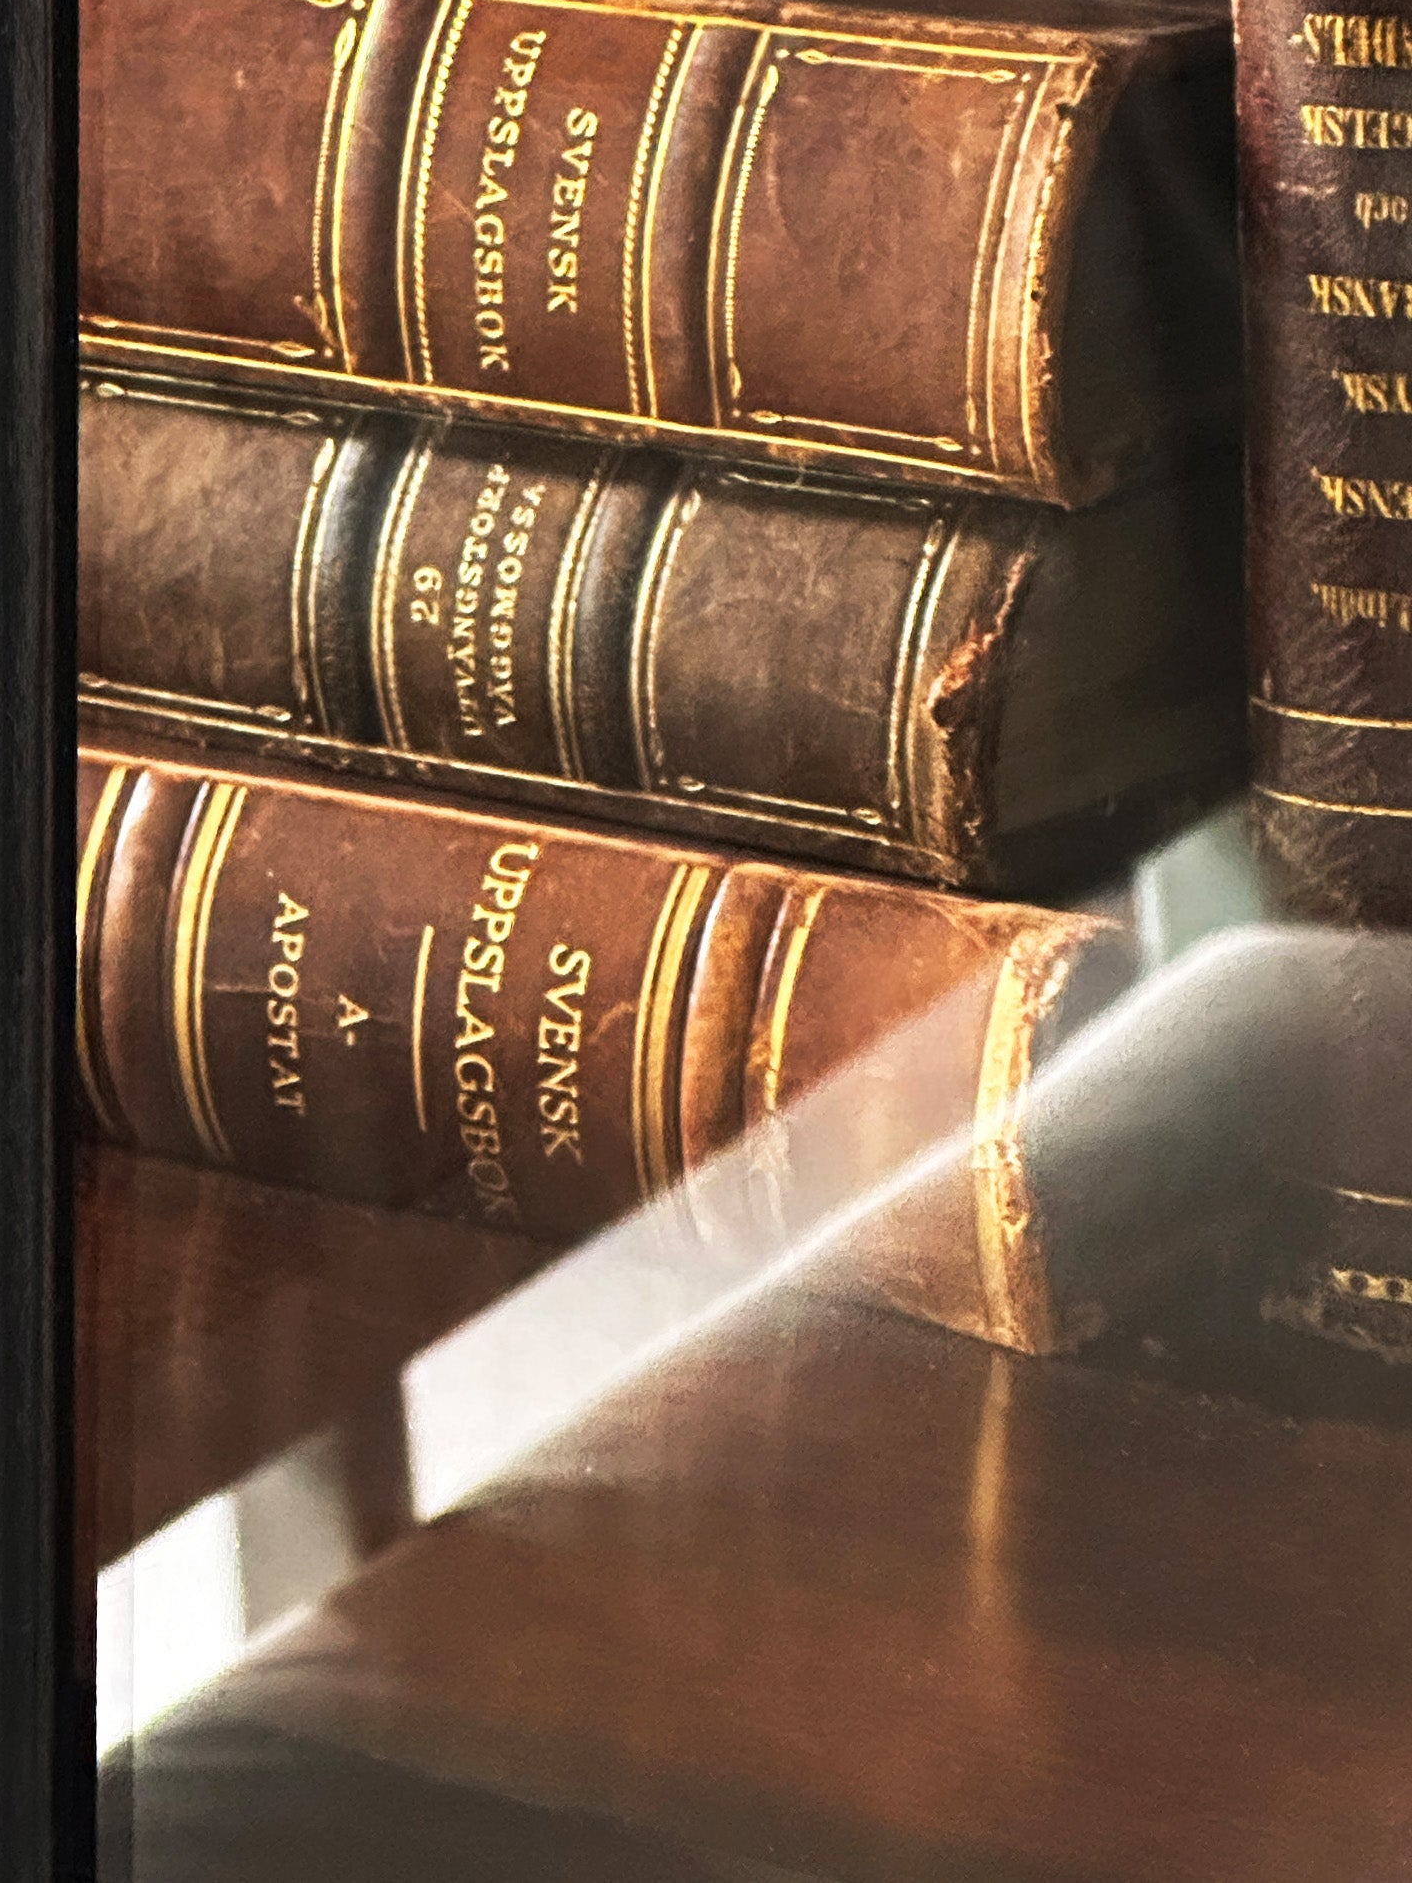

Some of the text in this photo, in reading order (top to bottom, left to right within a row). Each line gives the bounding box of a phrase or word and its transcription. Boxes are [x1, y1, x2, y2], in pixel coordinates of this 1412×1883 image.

[474, 30, 547, 372] UPPSLAGSBOK
[546, 106, 598, 314] SVENSK
[410, 566, 443, 625] 29
[267, 892, 310, 1117] APOSTAT
[454, 842, 540, 1216] UPPSLAGSBOK
[537, 943, 592, 1167] SVENSK
